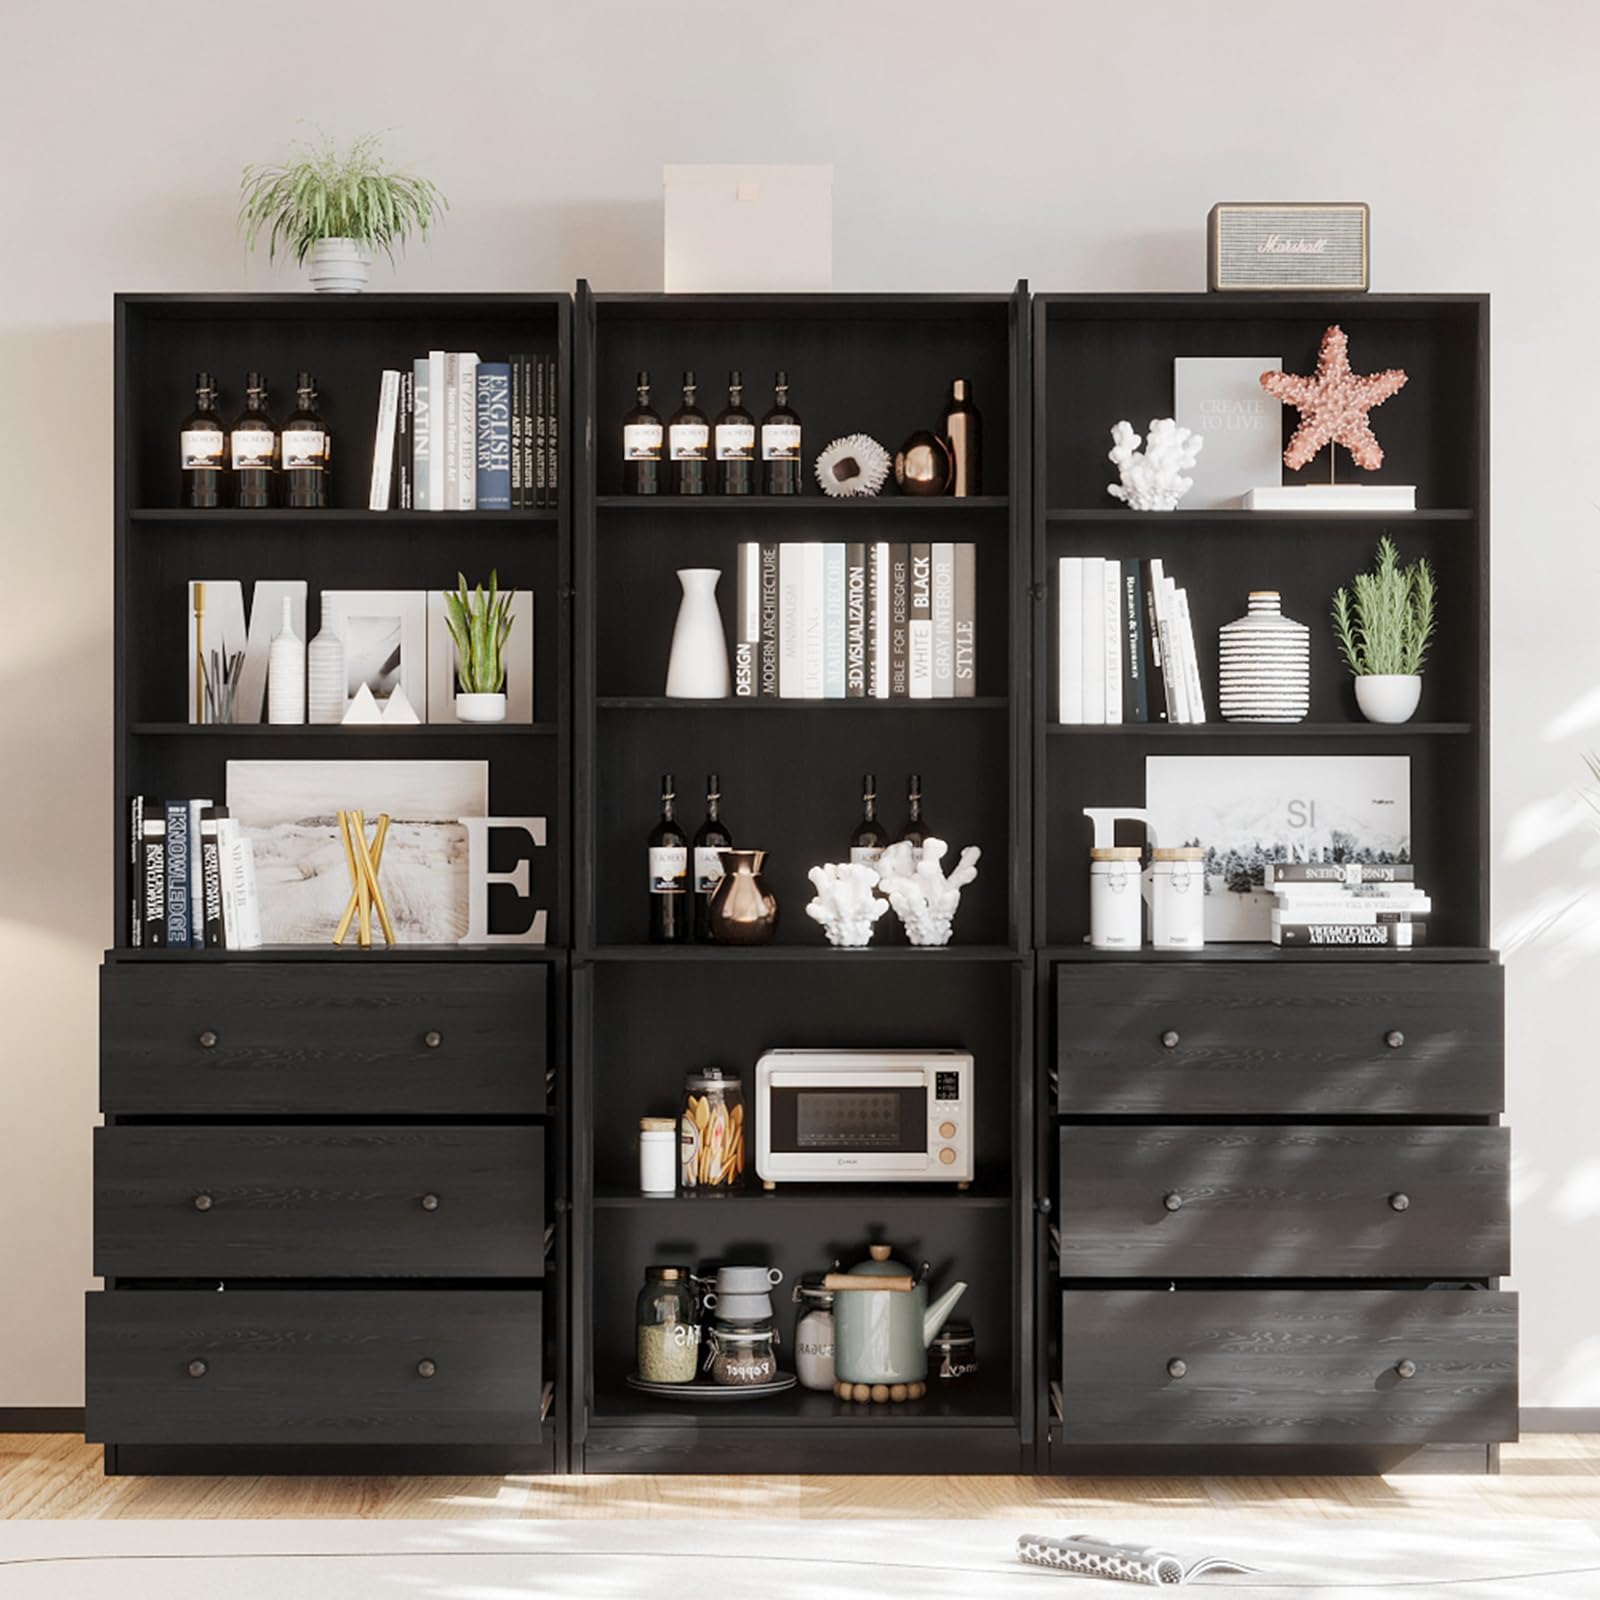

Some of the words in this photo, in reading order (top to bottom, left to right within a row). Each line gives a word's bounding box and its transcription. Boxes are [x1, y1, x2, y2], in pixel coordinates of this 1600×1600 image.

[1258, 233, 1328, 253] Marshall
[478, 375, 492, 472] DICTIONARY
[491, 374, 509, 472] ENGLISH
[1199, 399, 1264, 414] CREATE
[763, 548, 776, 638] ARCHITECTURE
[894, 562, 906, 623] DESIGNER
[913, 556, 930, 608] BLACK
[935, 562, 951, 634] INTERIOR
[894, 629, 906, 655] FOR
[914, 628, 929, 679] WHITE
[935, 638, 951, 680] GRAY
[956, 621, 974, 679] STYLE
[736, 643, 751, 696] DESIGN
[763, 640, 776, 694] MODERN
[894, 660, 906, 694] BIBLE
[1287, 799, 1315, 829] SI
[1305, 865, 1346, 882] QUEENS
[1361, 867, 1394, 882] KINGS
[1308, 925, 1388, 936] ENCYCLOPEDIA
[1309, 934, 1357, 944] CENTURY
